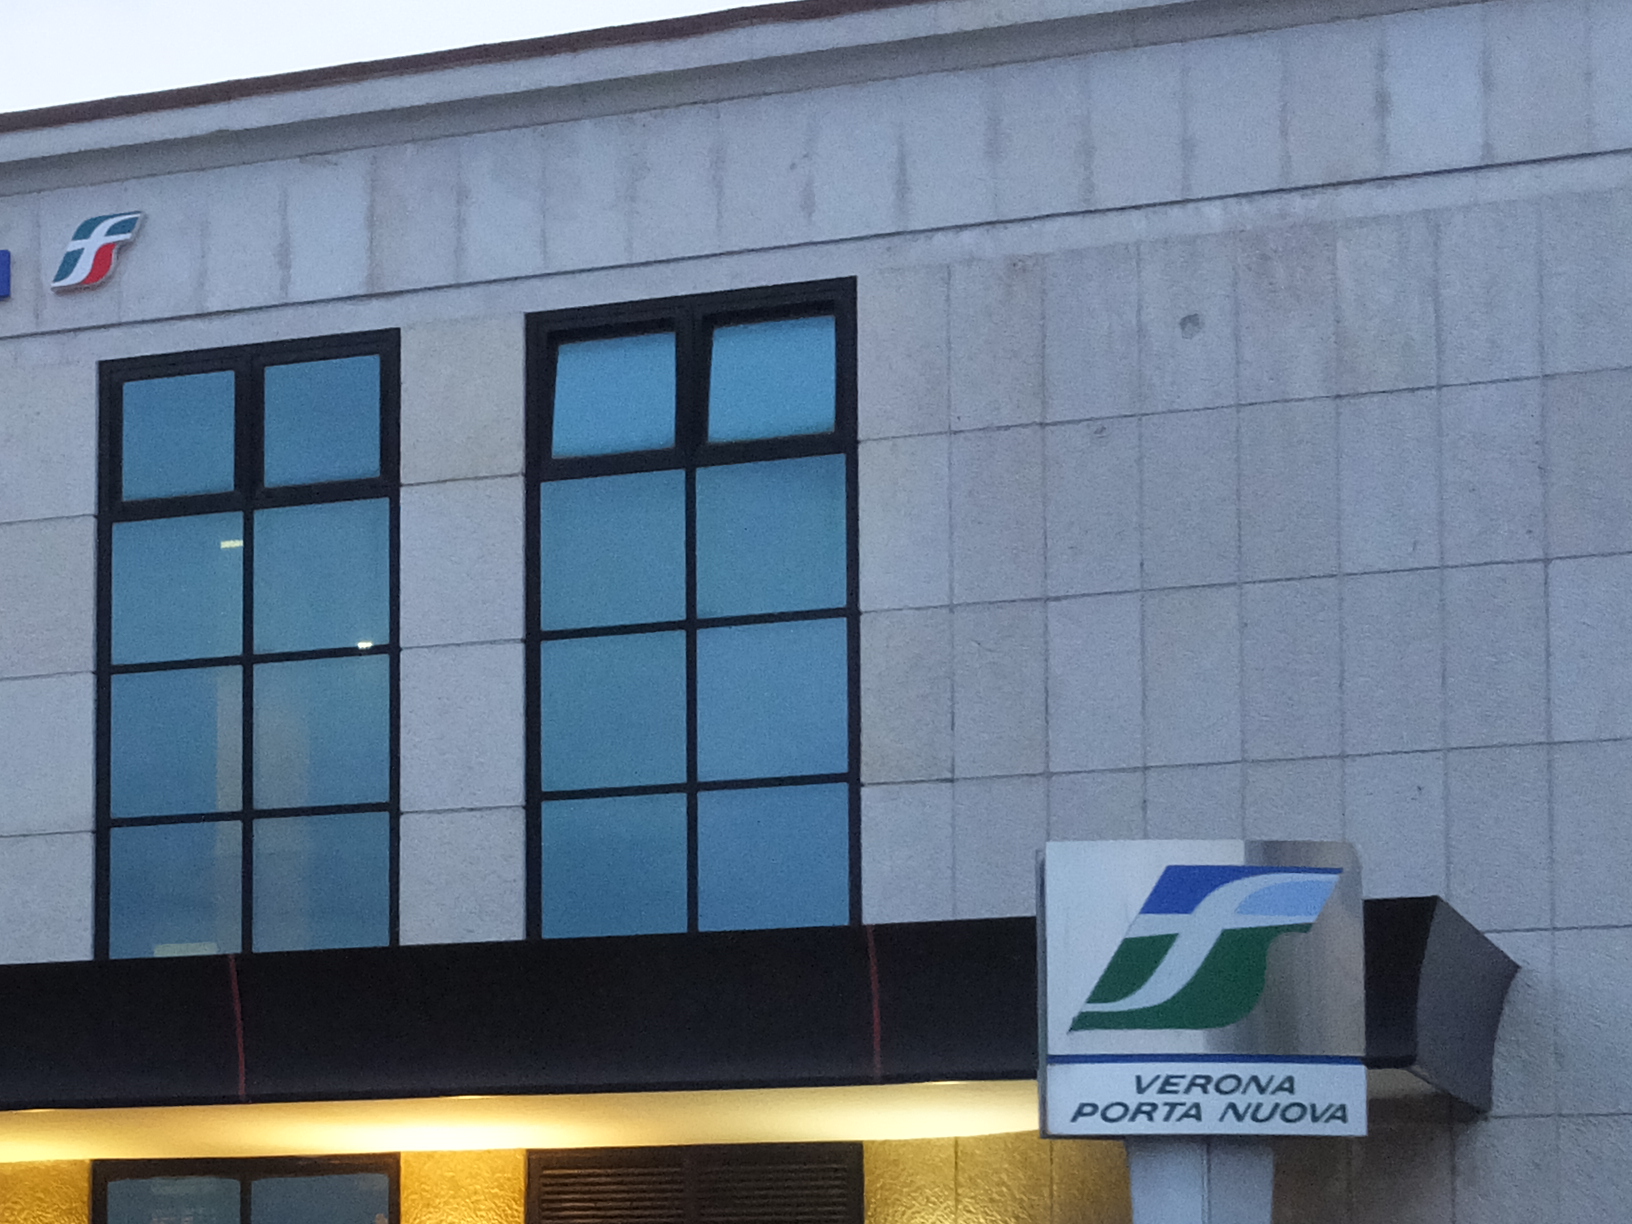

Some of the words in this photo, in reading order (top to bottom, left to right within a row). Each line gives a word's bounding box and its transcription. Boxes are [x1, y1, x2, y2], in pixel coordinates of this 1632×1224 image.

[1134, 1074, 1296, 1096] VERONA
[1070, 1101, 1205, 1124] PORTA
[1218, 1102, 1349, 1125] NUOVA
